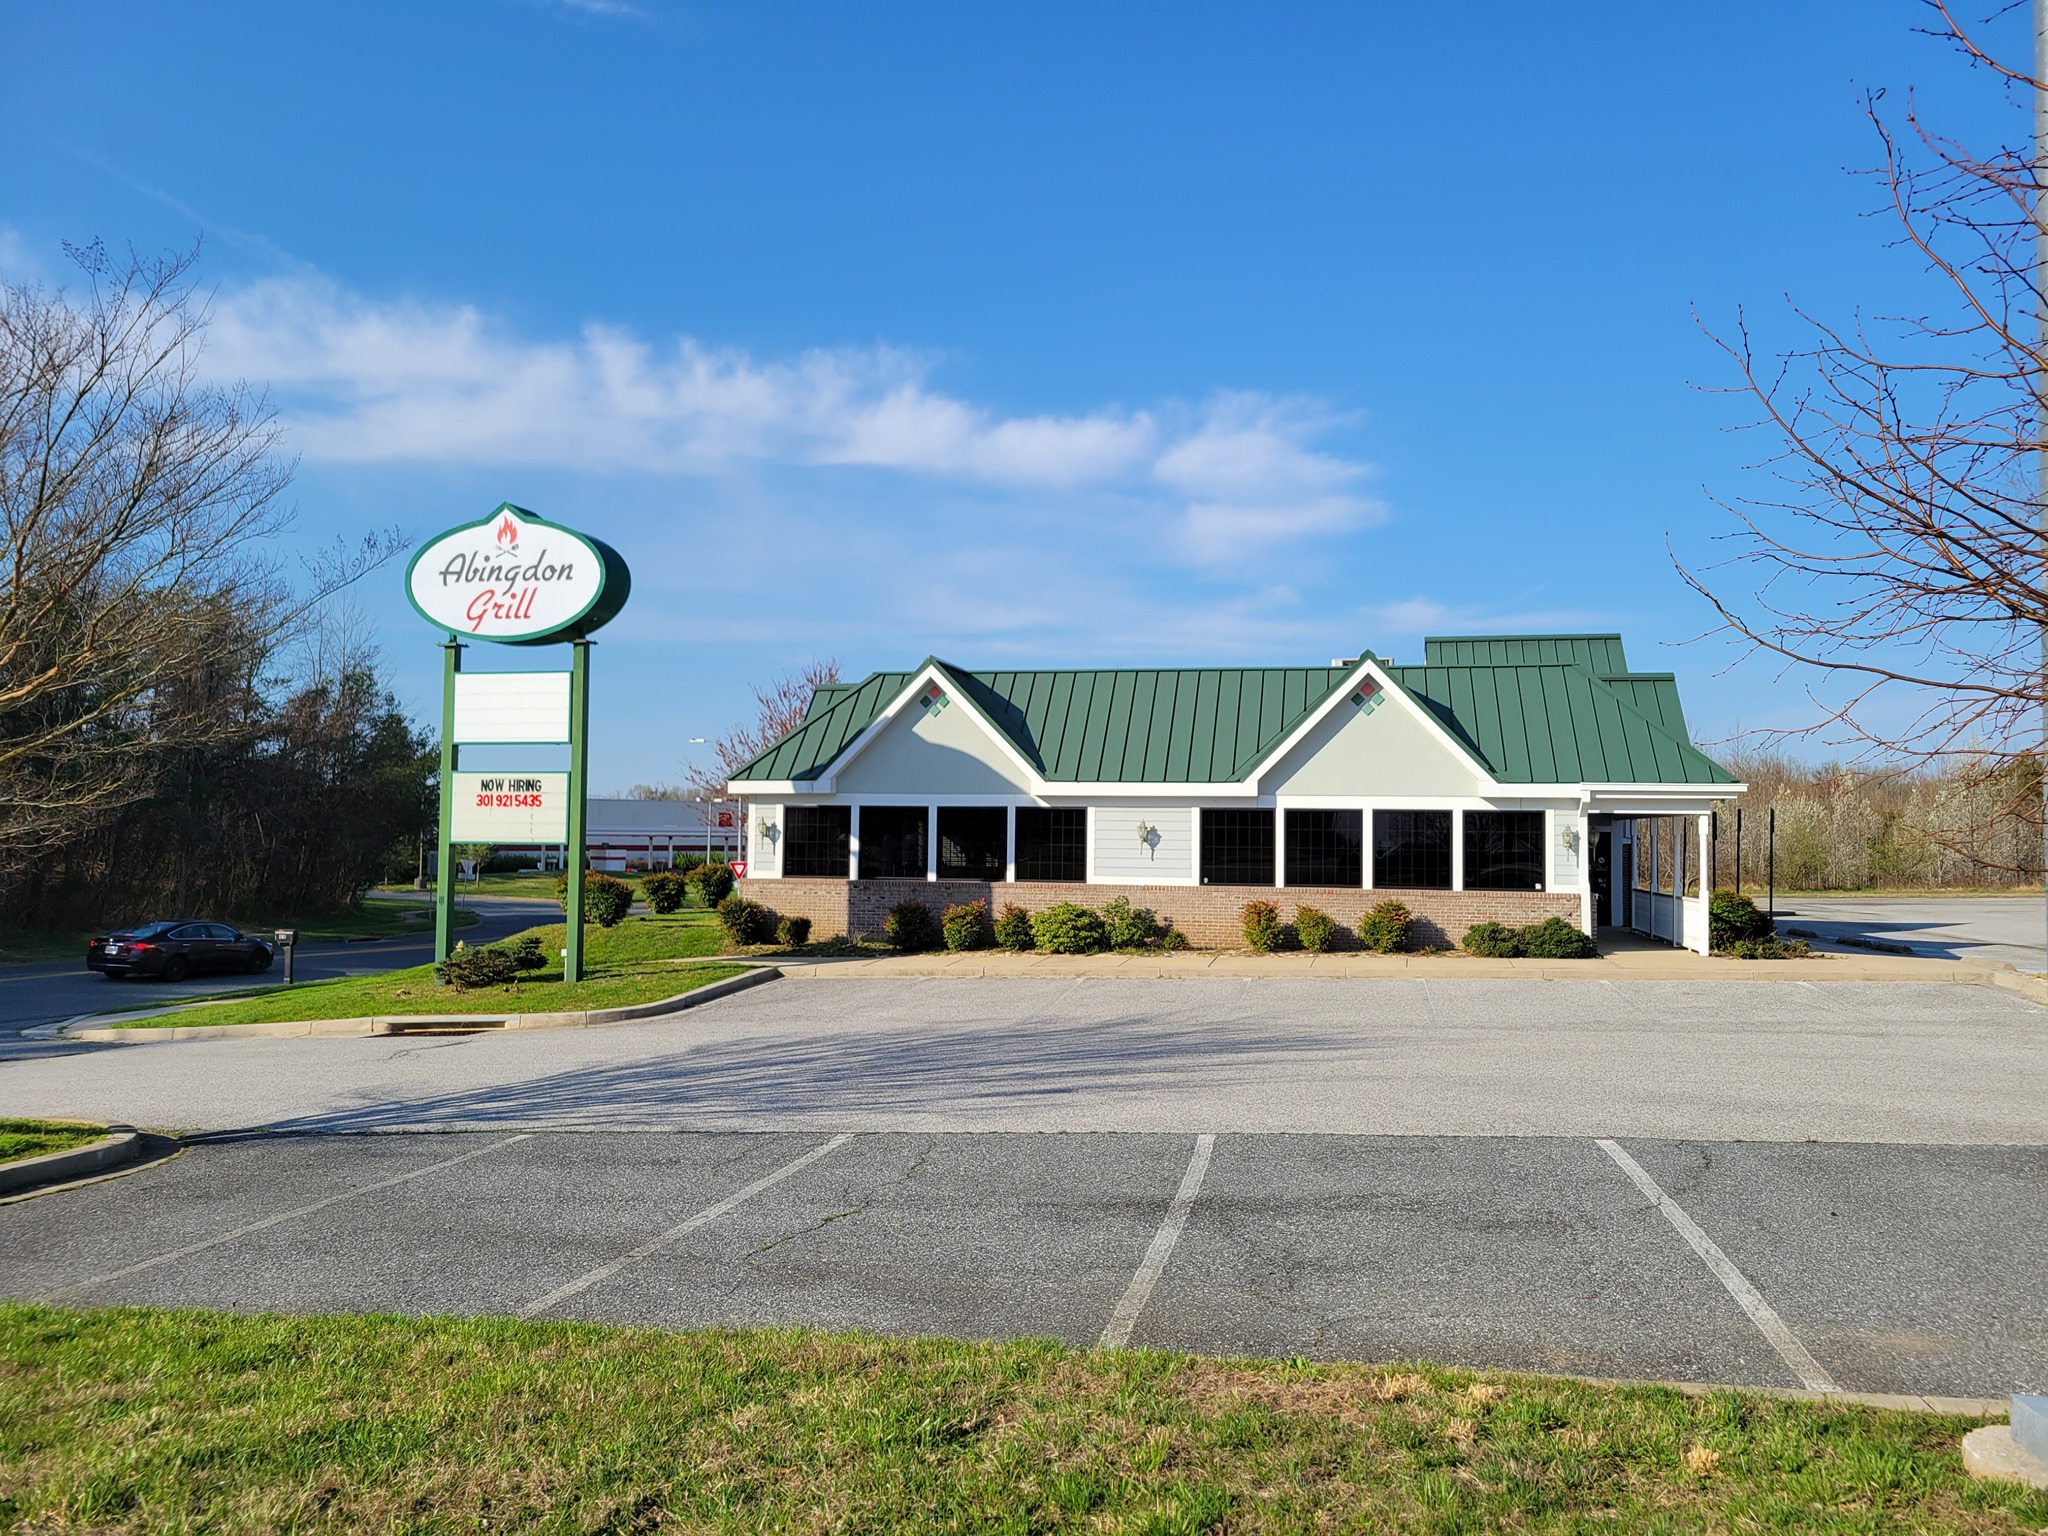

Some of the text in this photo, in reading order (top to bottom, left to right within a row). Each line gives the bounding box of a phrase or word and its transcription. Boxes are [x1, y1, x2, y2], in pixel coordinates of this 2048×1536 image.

[439, 549, 573, 596] Abingdon
[466, 587, 538, 632] Grill
[481, 779, 542, 792] NOW HIRING
[476, 794, 493, 807] 301
